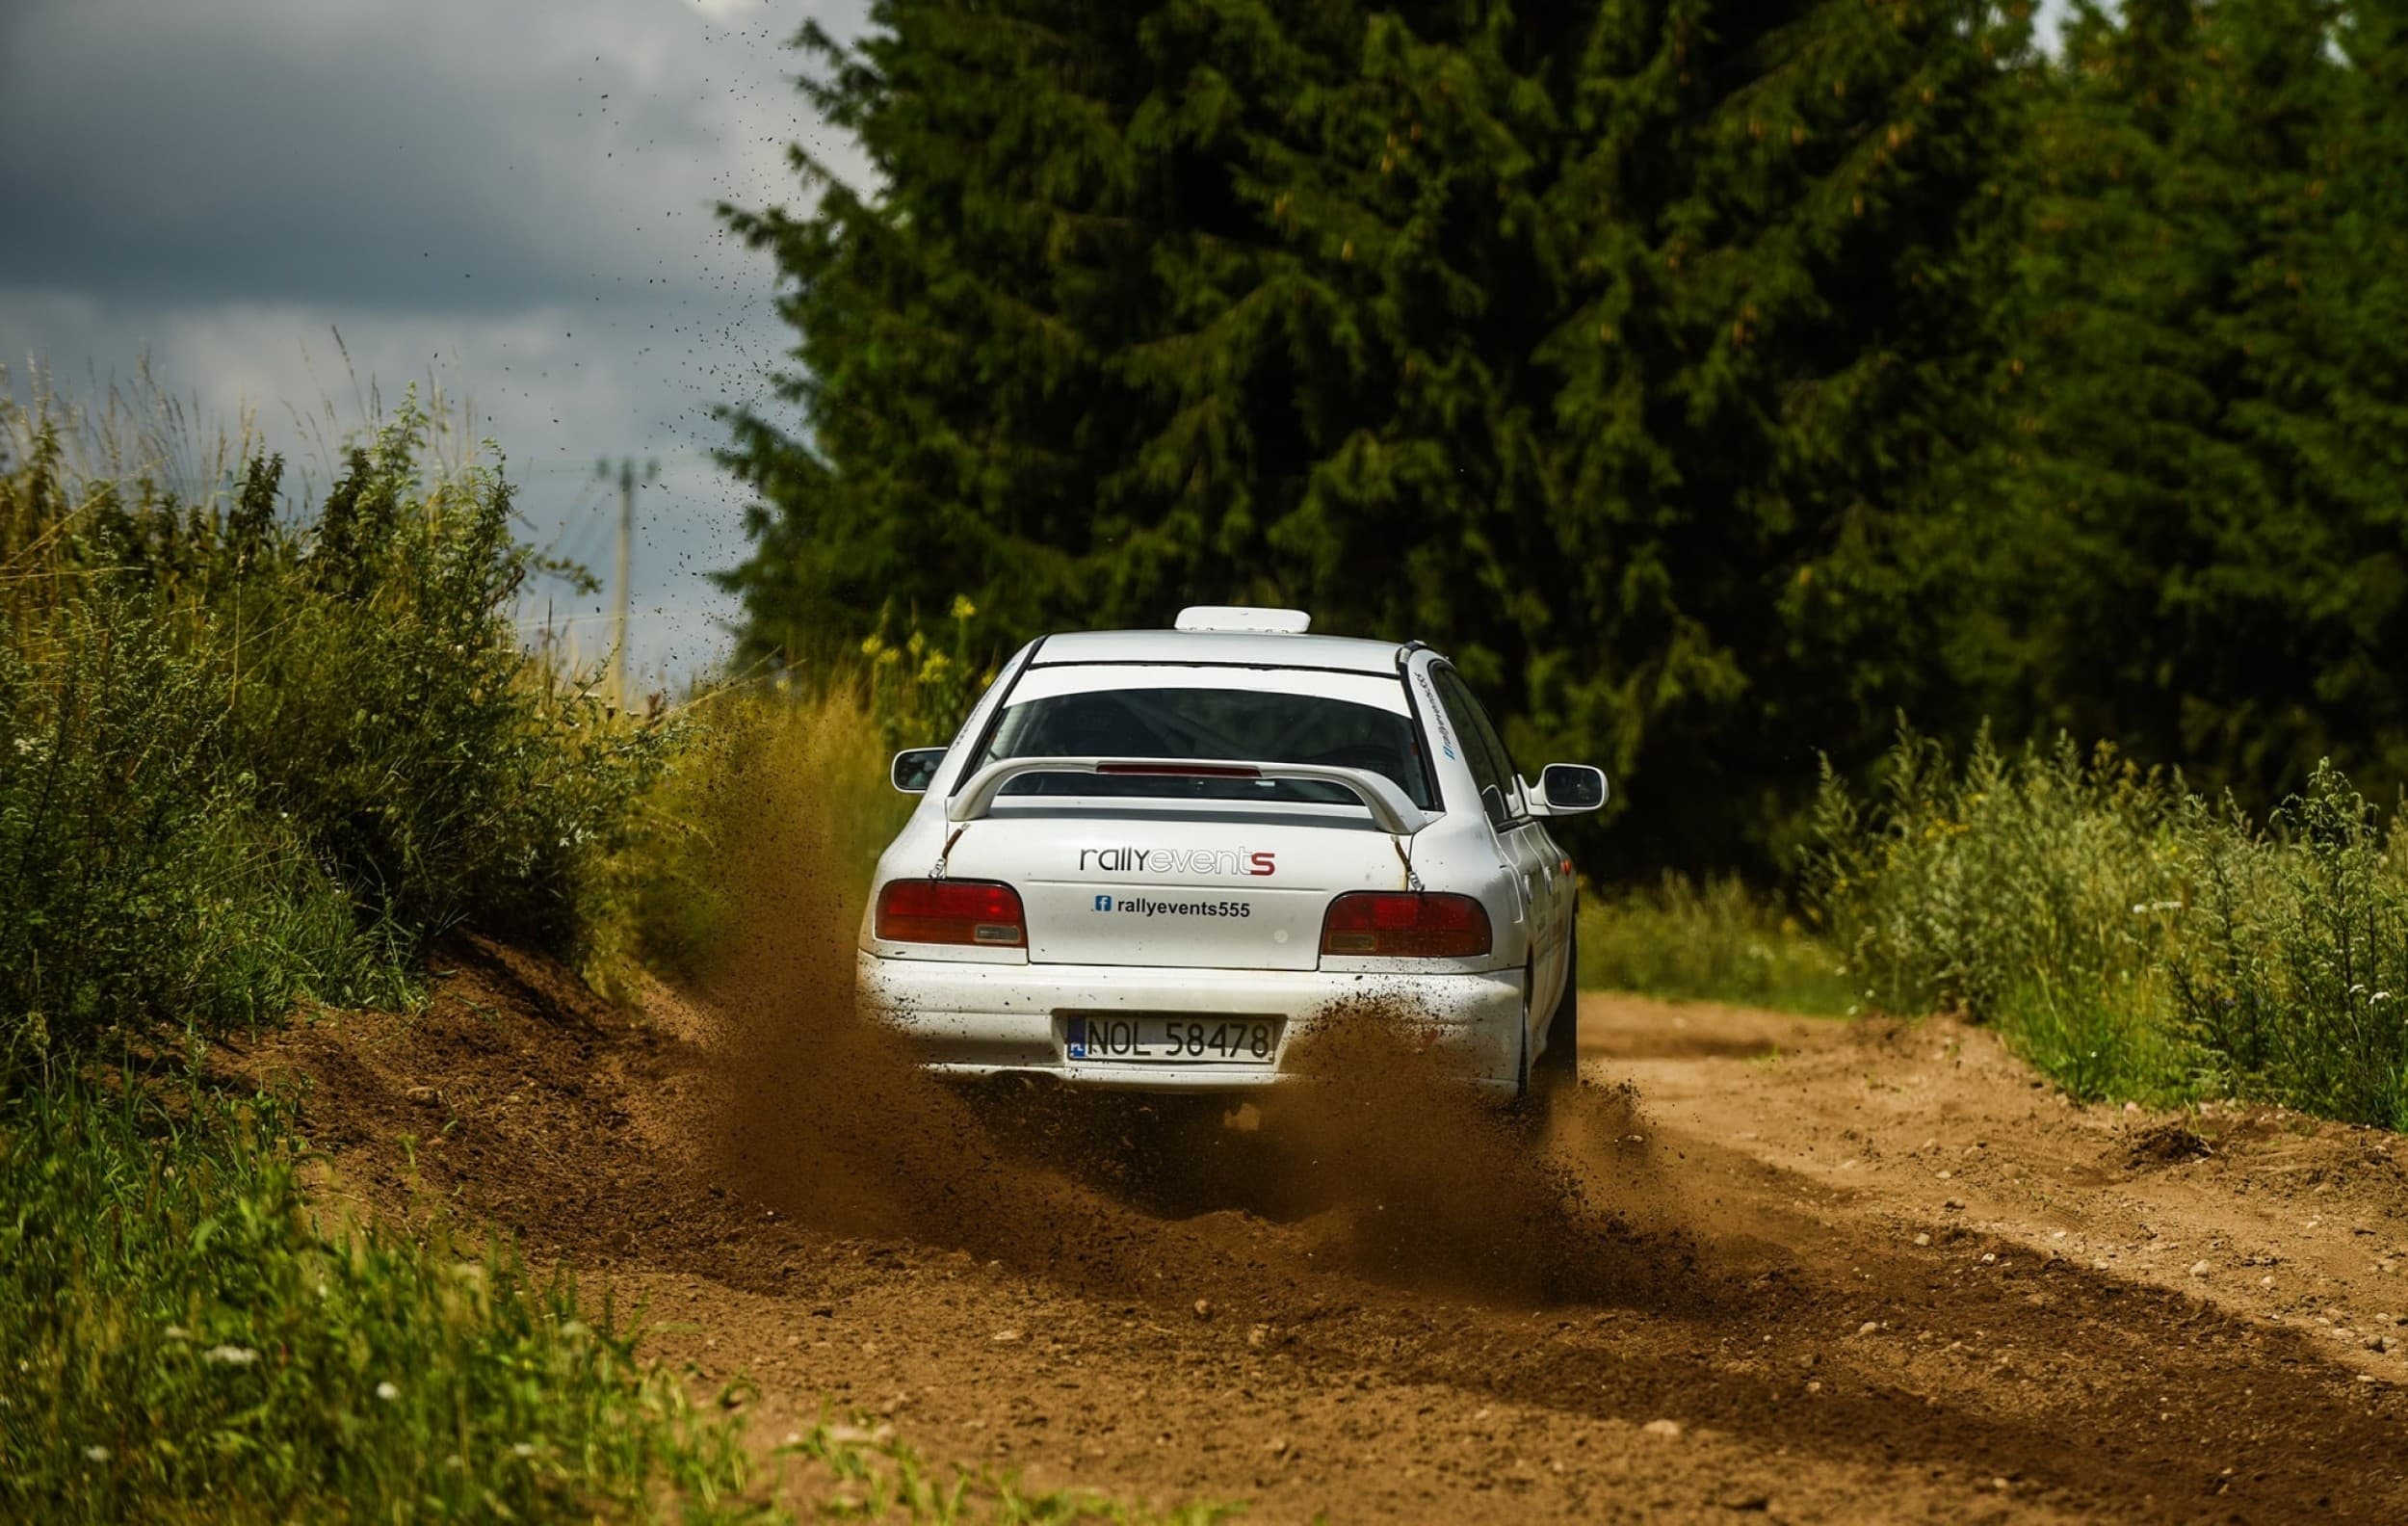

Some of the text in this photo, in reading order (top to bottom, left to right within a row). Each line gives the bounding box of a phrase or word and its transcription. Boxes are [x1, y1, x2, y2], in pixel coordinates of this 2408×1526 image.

[1080, 847, 1275, 876] rallyevents
[1117, 898, 1250, 917] rallyevents555
[1070, 1042, 1084, 1051] PL
[1088, 1020, 1269, 1058] NOL 58478
